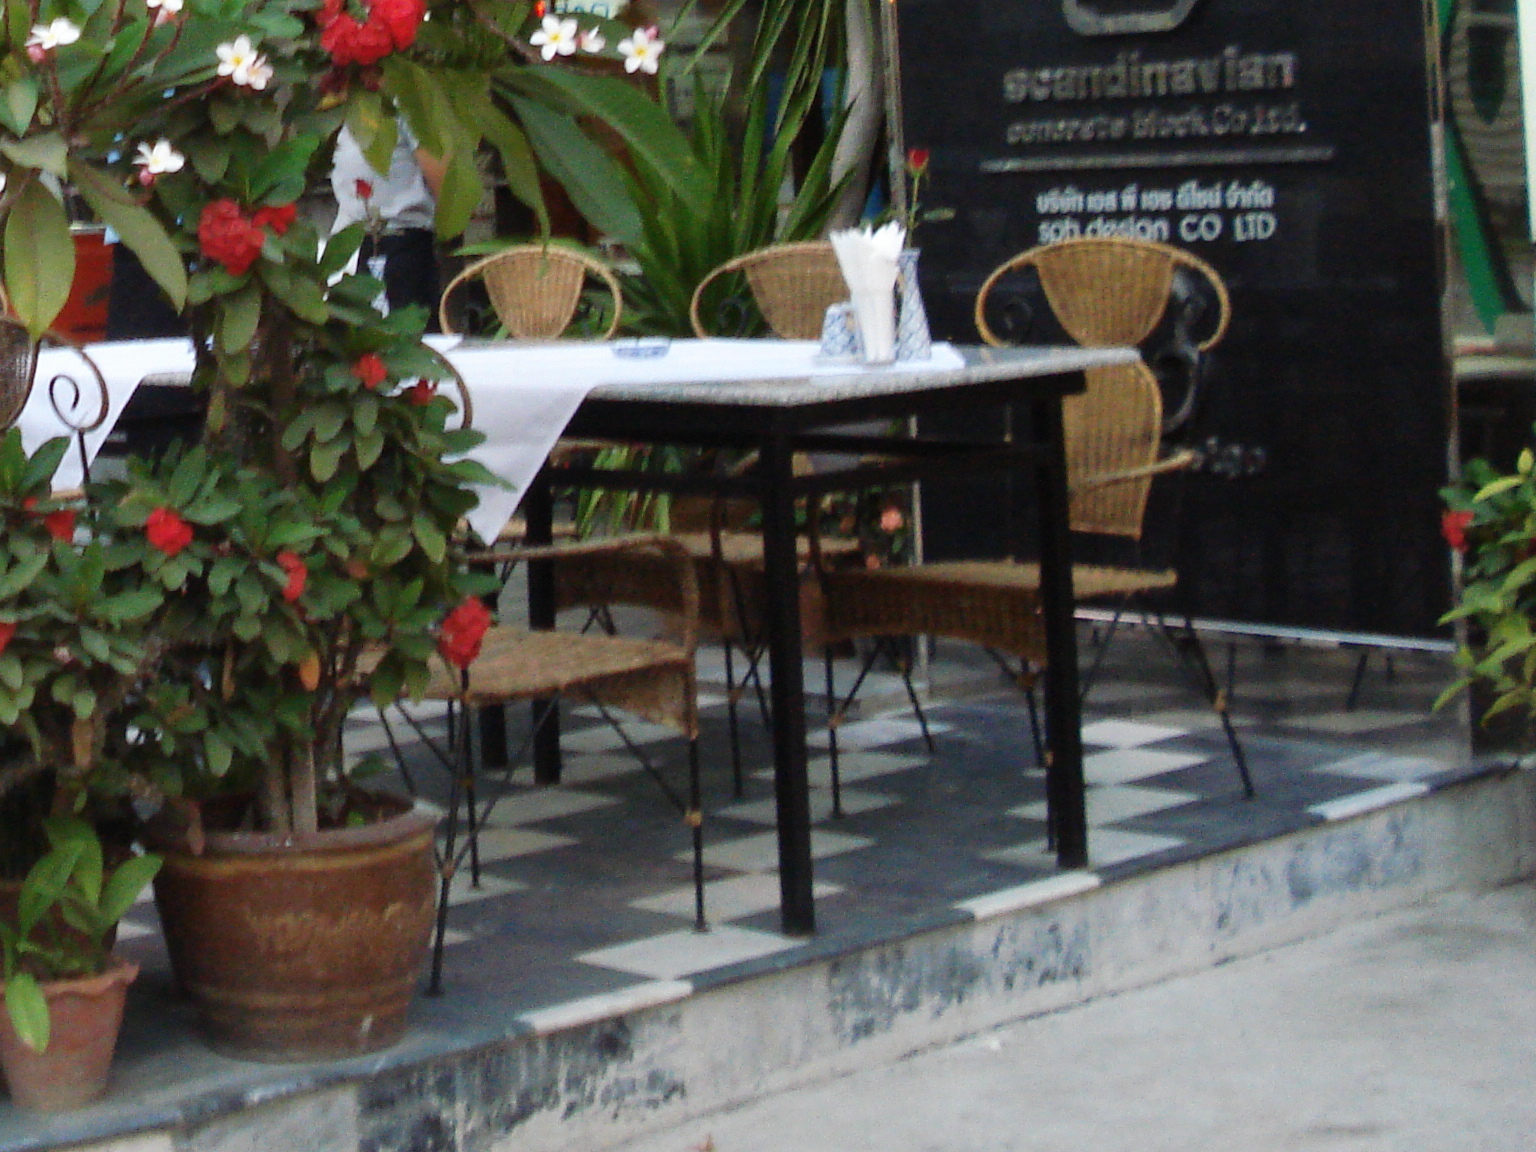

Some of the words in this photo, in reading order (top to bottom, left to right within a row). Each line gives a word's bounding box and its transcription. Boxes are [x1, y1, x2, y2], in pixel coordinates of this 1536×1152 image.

[1003, 45, 1296, 103] scandinavian
[1179, 212, 1223, 242] CO
[1233, 211, 1278, 242] LTD
